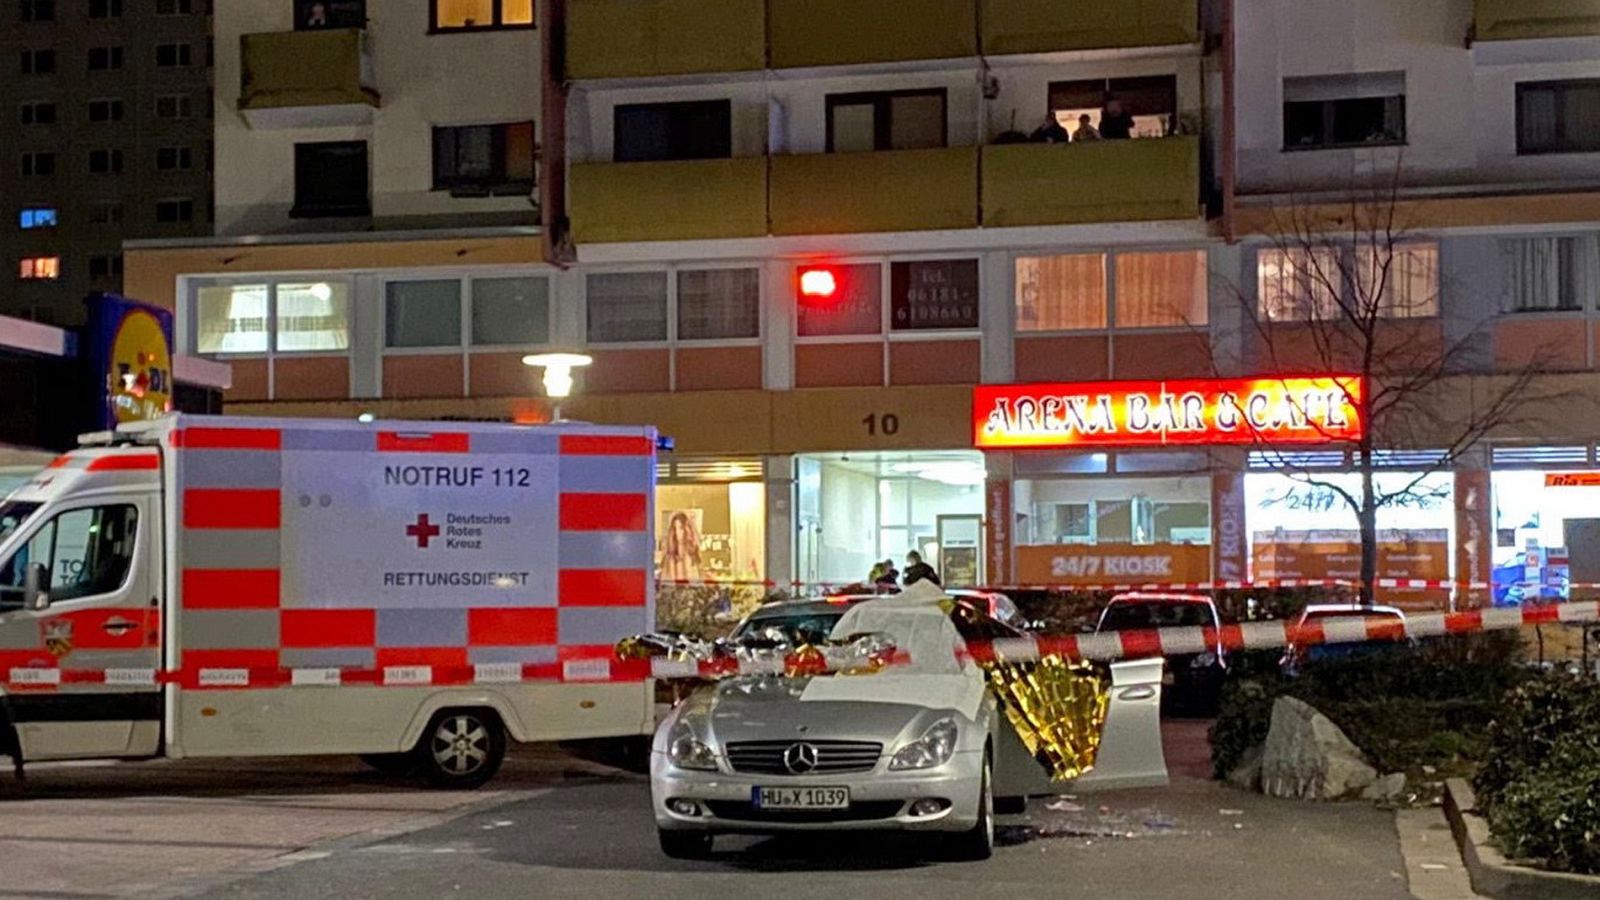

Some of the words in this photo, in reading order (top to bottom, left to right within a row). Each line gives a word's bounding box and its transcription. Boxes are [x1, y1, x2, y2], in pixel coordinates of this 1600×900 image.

[986, 397, 1115, 433] ARENA
[1128, 393, 1206, 432] BAR
[862, 413, 899, 436] 10
[384, 465, 485, 487] NOTRUF
[491, 467, 530, 488] 112
[446, 512, 511, 525] Deutsches
[446, 525, 482, 537] Rotes
[446, 538, 482, 550] Kreuz
[1051, 556, 1099, 577] 24/7
[1103, 556, 1172, 576] KIOSK
[761, 790, 782, 805] HU
[792, 790, 802, 806] X
[805, 789, 846, 806] 1039
